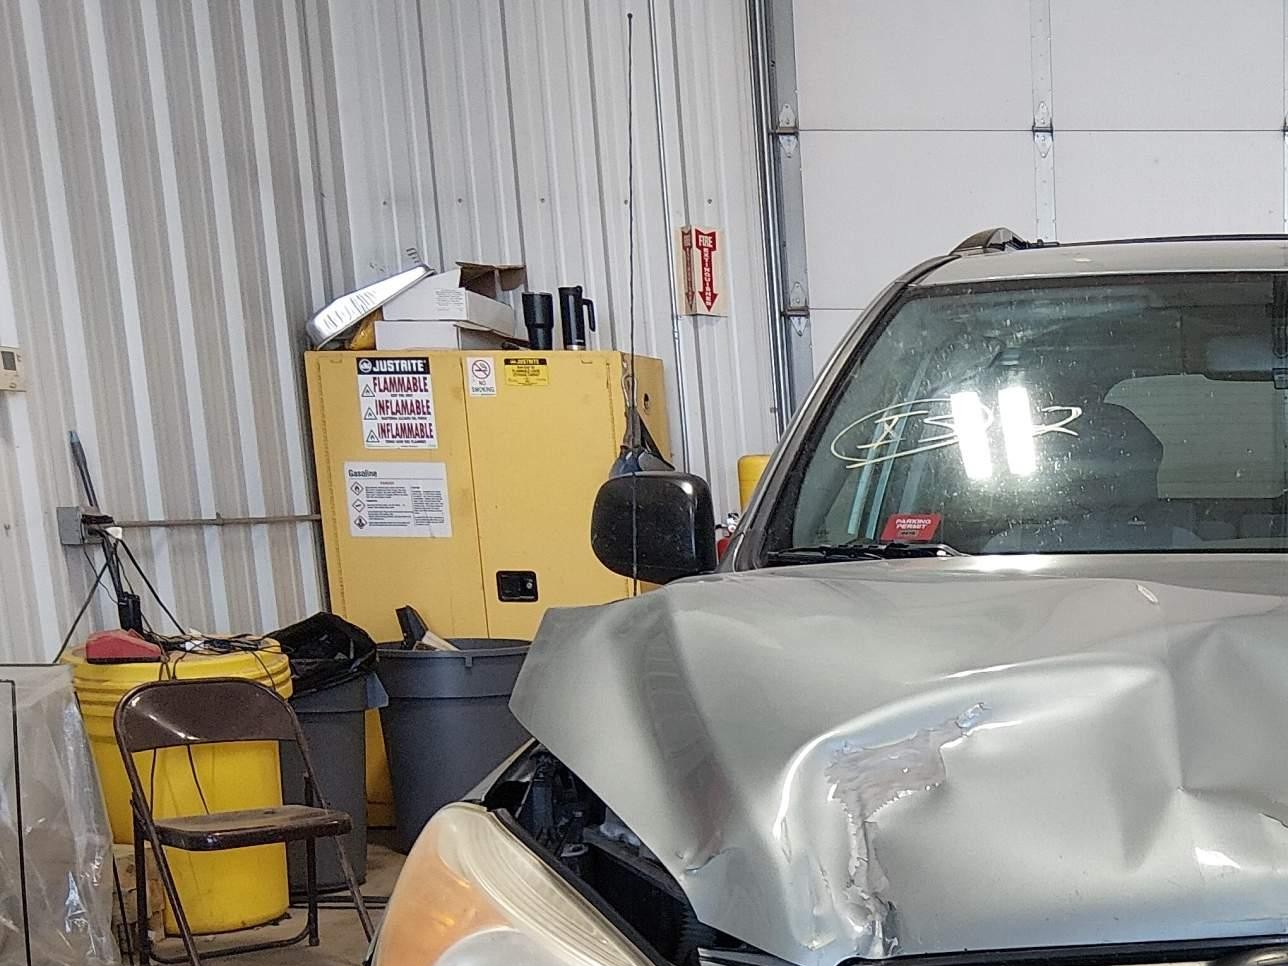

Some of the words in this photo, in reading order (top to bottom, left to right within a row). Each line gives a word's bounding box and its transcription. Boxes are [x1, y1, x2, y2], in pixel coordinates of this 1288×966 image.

[698, 235, 713, 248] FIRE
[372, 359, 425, 372] JUSTRITE
[372, 376, 429, 393] FLAMMABLE
[375, 399, 432, 415] INFLAMABLE
[377, 422, 434, 439] INFLAMMABLE
[348, 469, 378, 478] Gasoline
